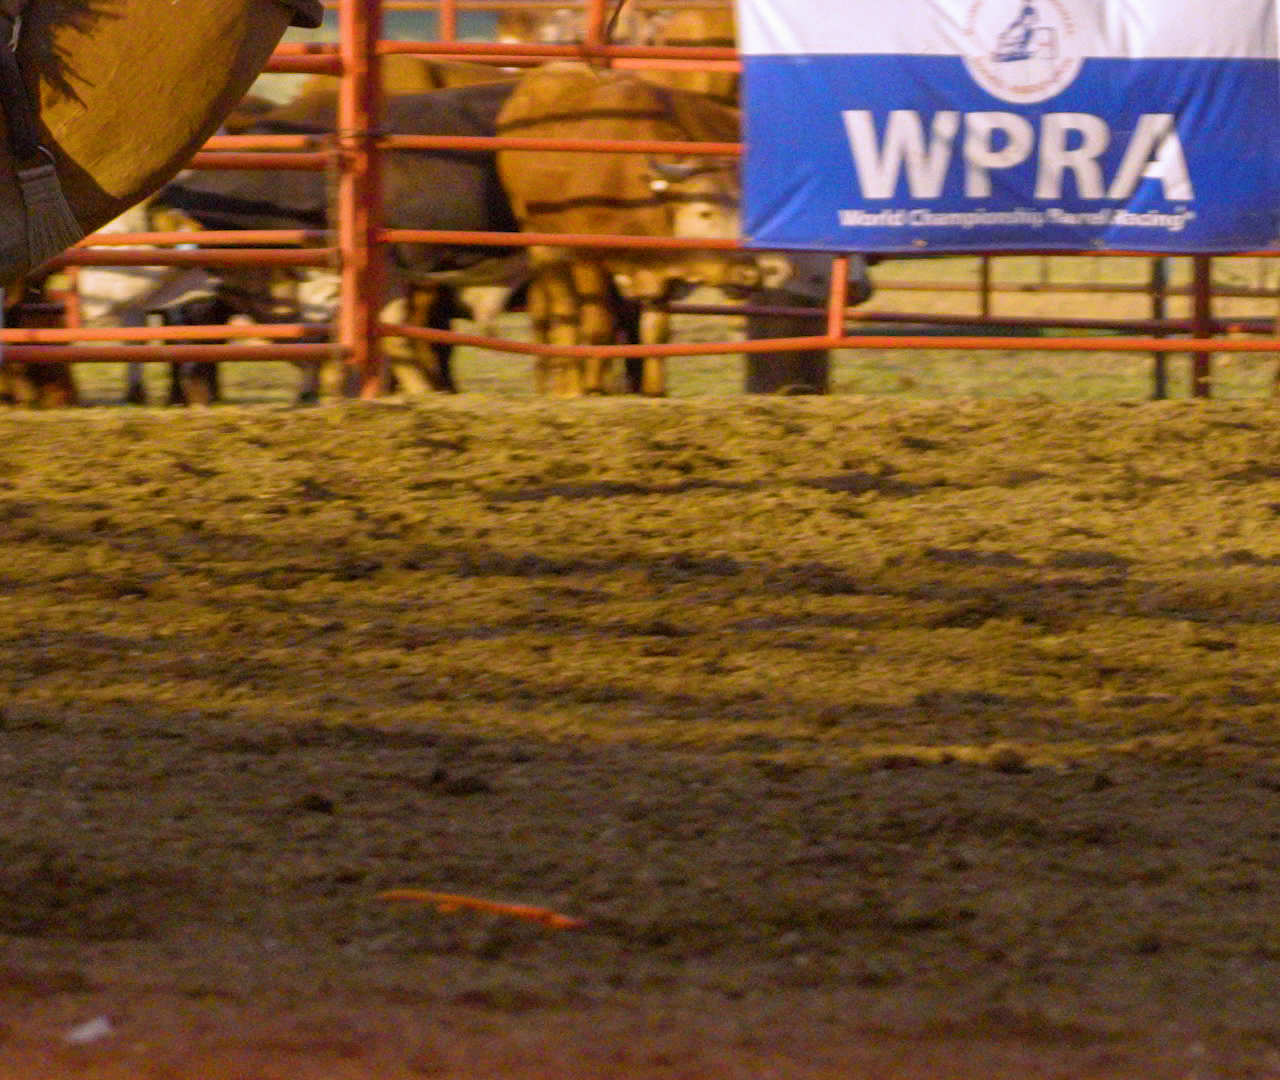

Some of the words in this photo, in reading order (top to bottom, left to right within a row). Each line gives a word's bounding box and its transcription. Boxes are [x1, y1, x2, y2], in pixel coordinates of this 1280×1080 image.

[841, 109, 1194, 202] WPRA
[838, 209, 903, 227] World
[910, 208, 1044, 229] Championship
